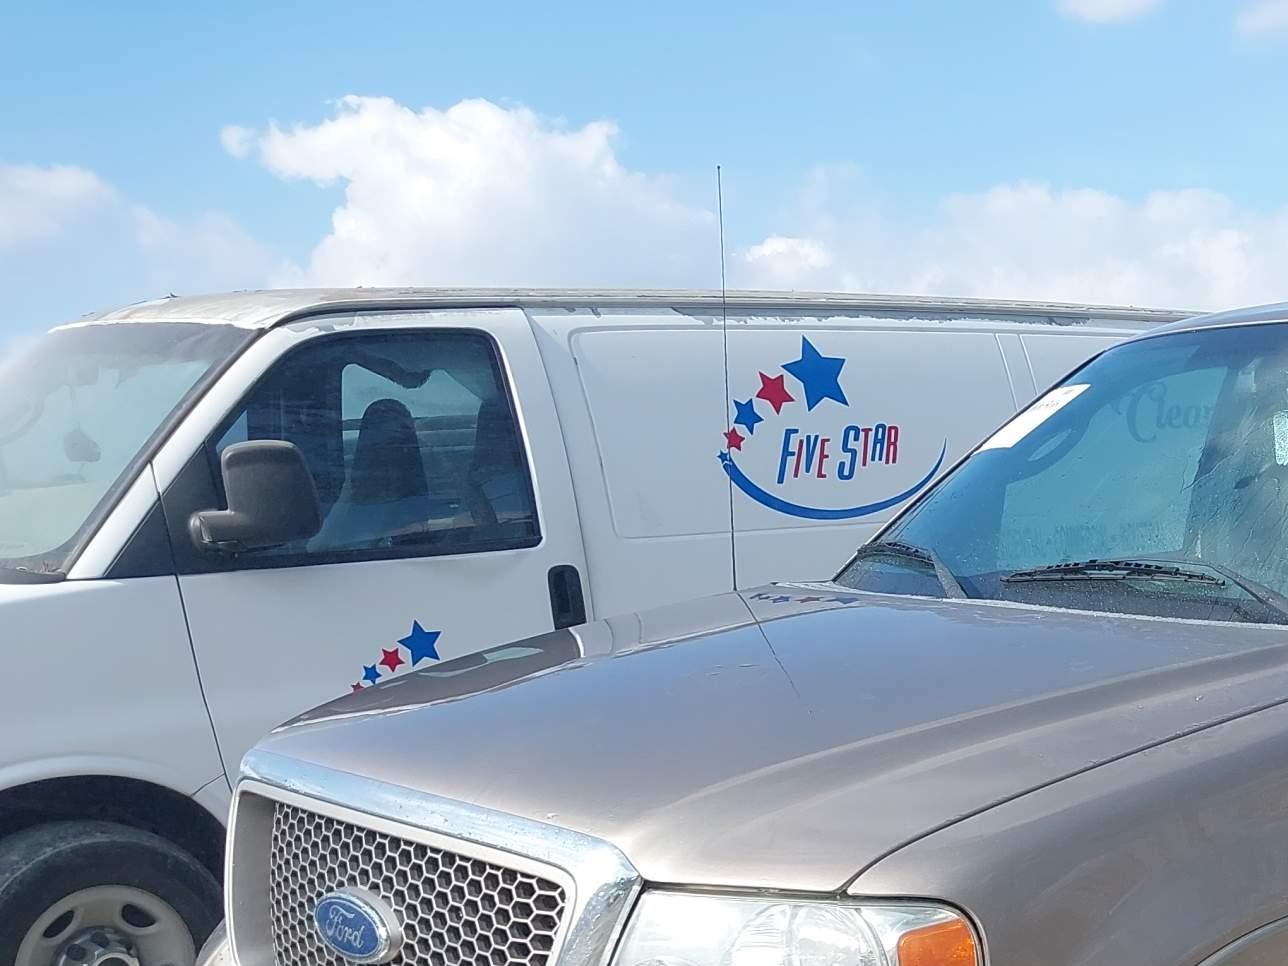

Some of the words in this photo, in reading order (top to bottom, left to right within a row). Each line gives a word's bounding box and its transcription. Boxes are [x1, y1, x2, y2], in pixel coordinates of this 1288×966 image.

[777, 427, 831, 484] FIVE
[837, 423, 900, 481] STAR
[326, 904, 365, 949] Ford
